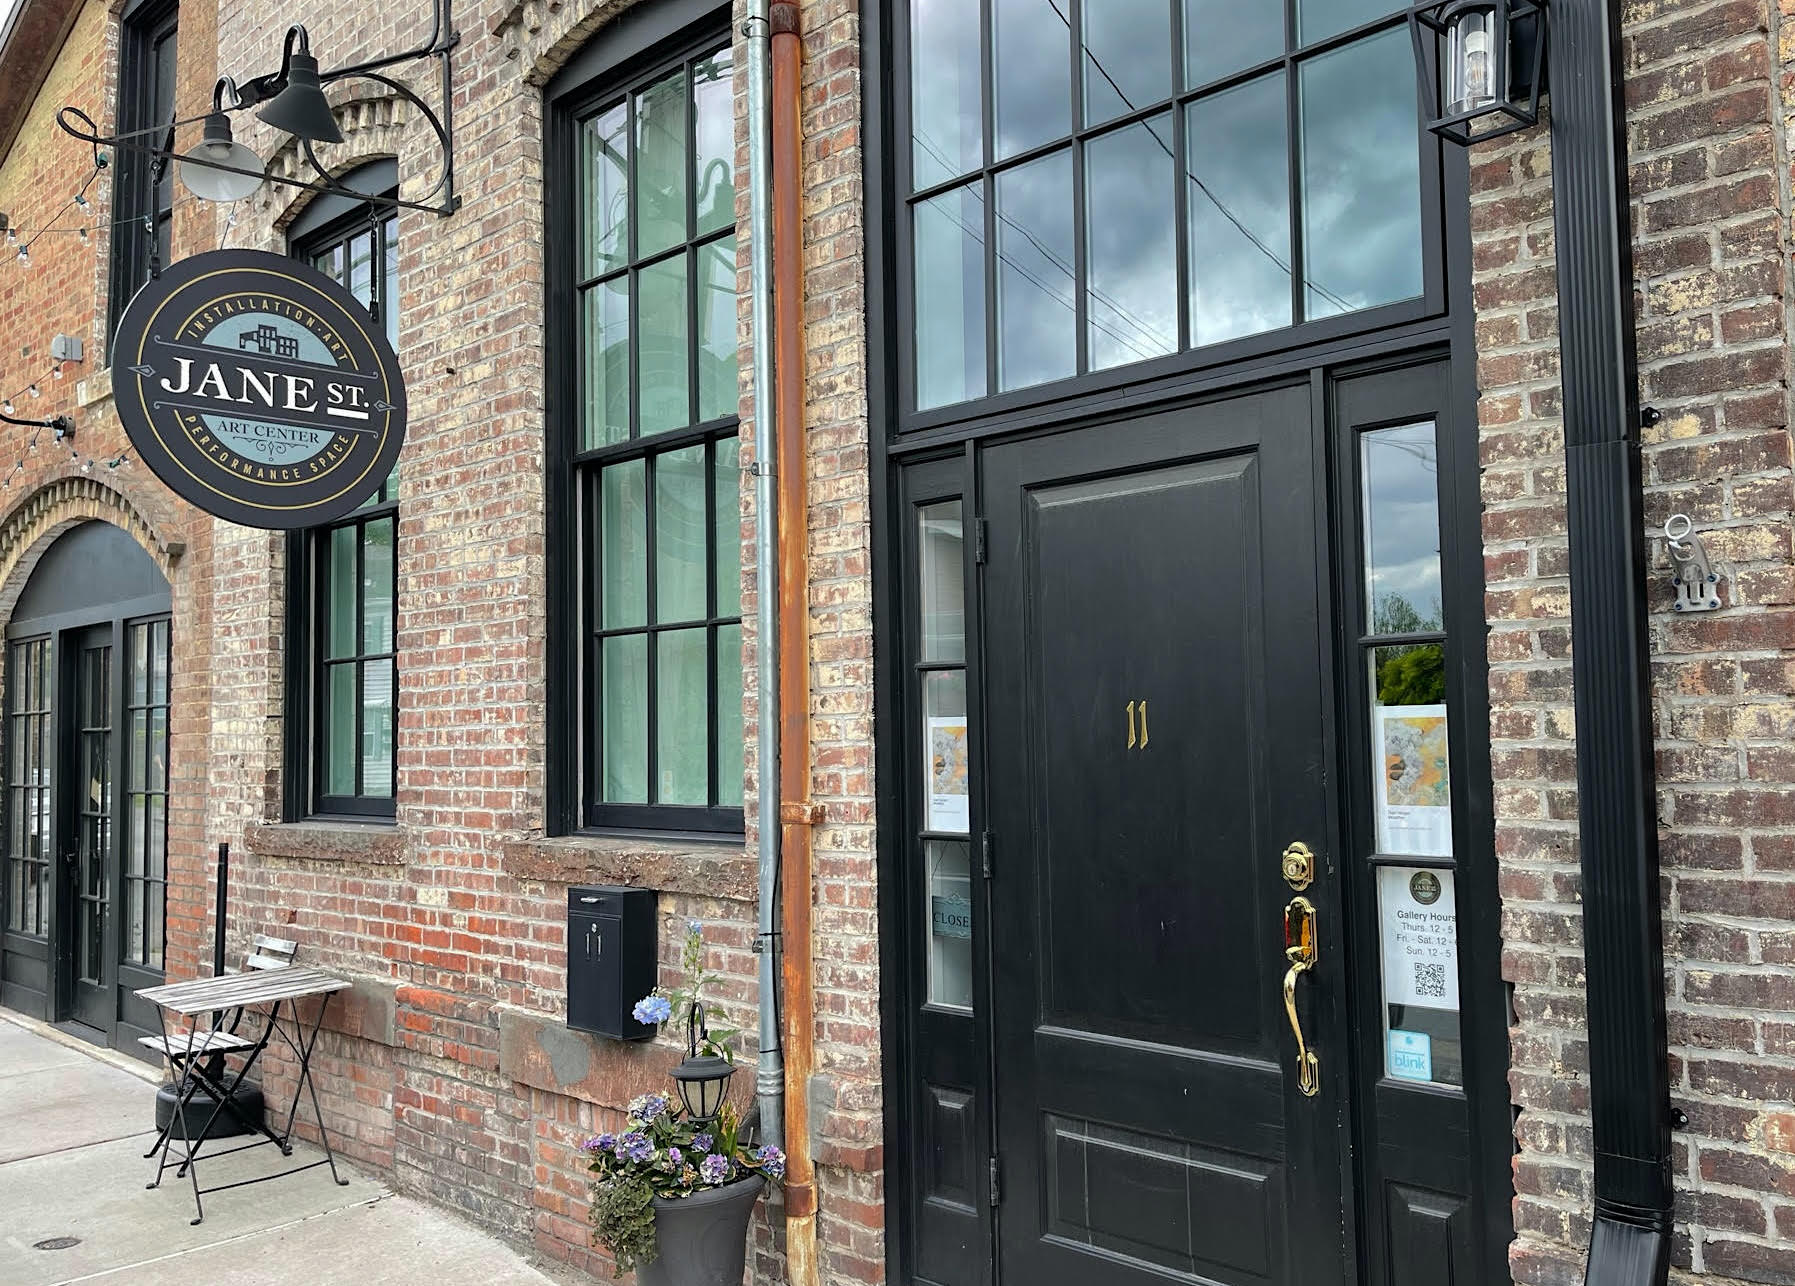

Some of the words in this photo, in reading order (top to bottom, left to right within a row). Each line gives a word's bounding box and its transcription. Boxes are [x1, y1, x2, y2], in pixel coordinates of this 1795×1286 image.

[188, 299, 316, 338] INSTALLATION
[322, 333, 349, 361] ART
[160, 357, 318, 413] JANE
[327, 382, 370, 408] ST.
[217, 420, 251, 434] ART
[254, 425, 320, 444] CENTER
[185, 415, 300, 480] PERFORMANCE
[310, 434, 349, 473] SPACE
[1126, 700, 1149, 750] 11
[1397, 910, 1428, 922] Gallery
[1430, 912, 1457, 922] Hours
[1430, 924, 1440, 933] 12
[1448, 926, 1454, 934] 5
[1437, 937, 1447, 945] 12
[1428, 948, 1438, 957] 12
[1446, 949, 1452, 958] 5
[1394, 1053, 1425, 1070] blink
